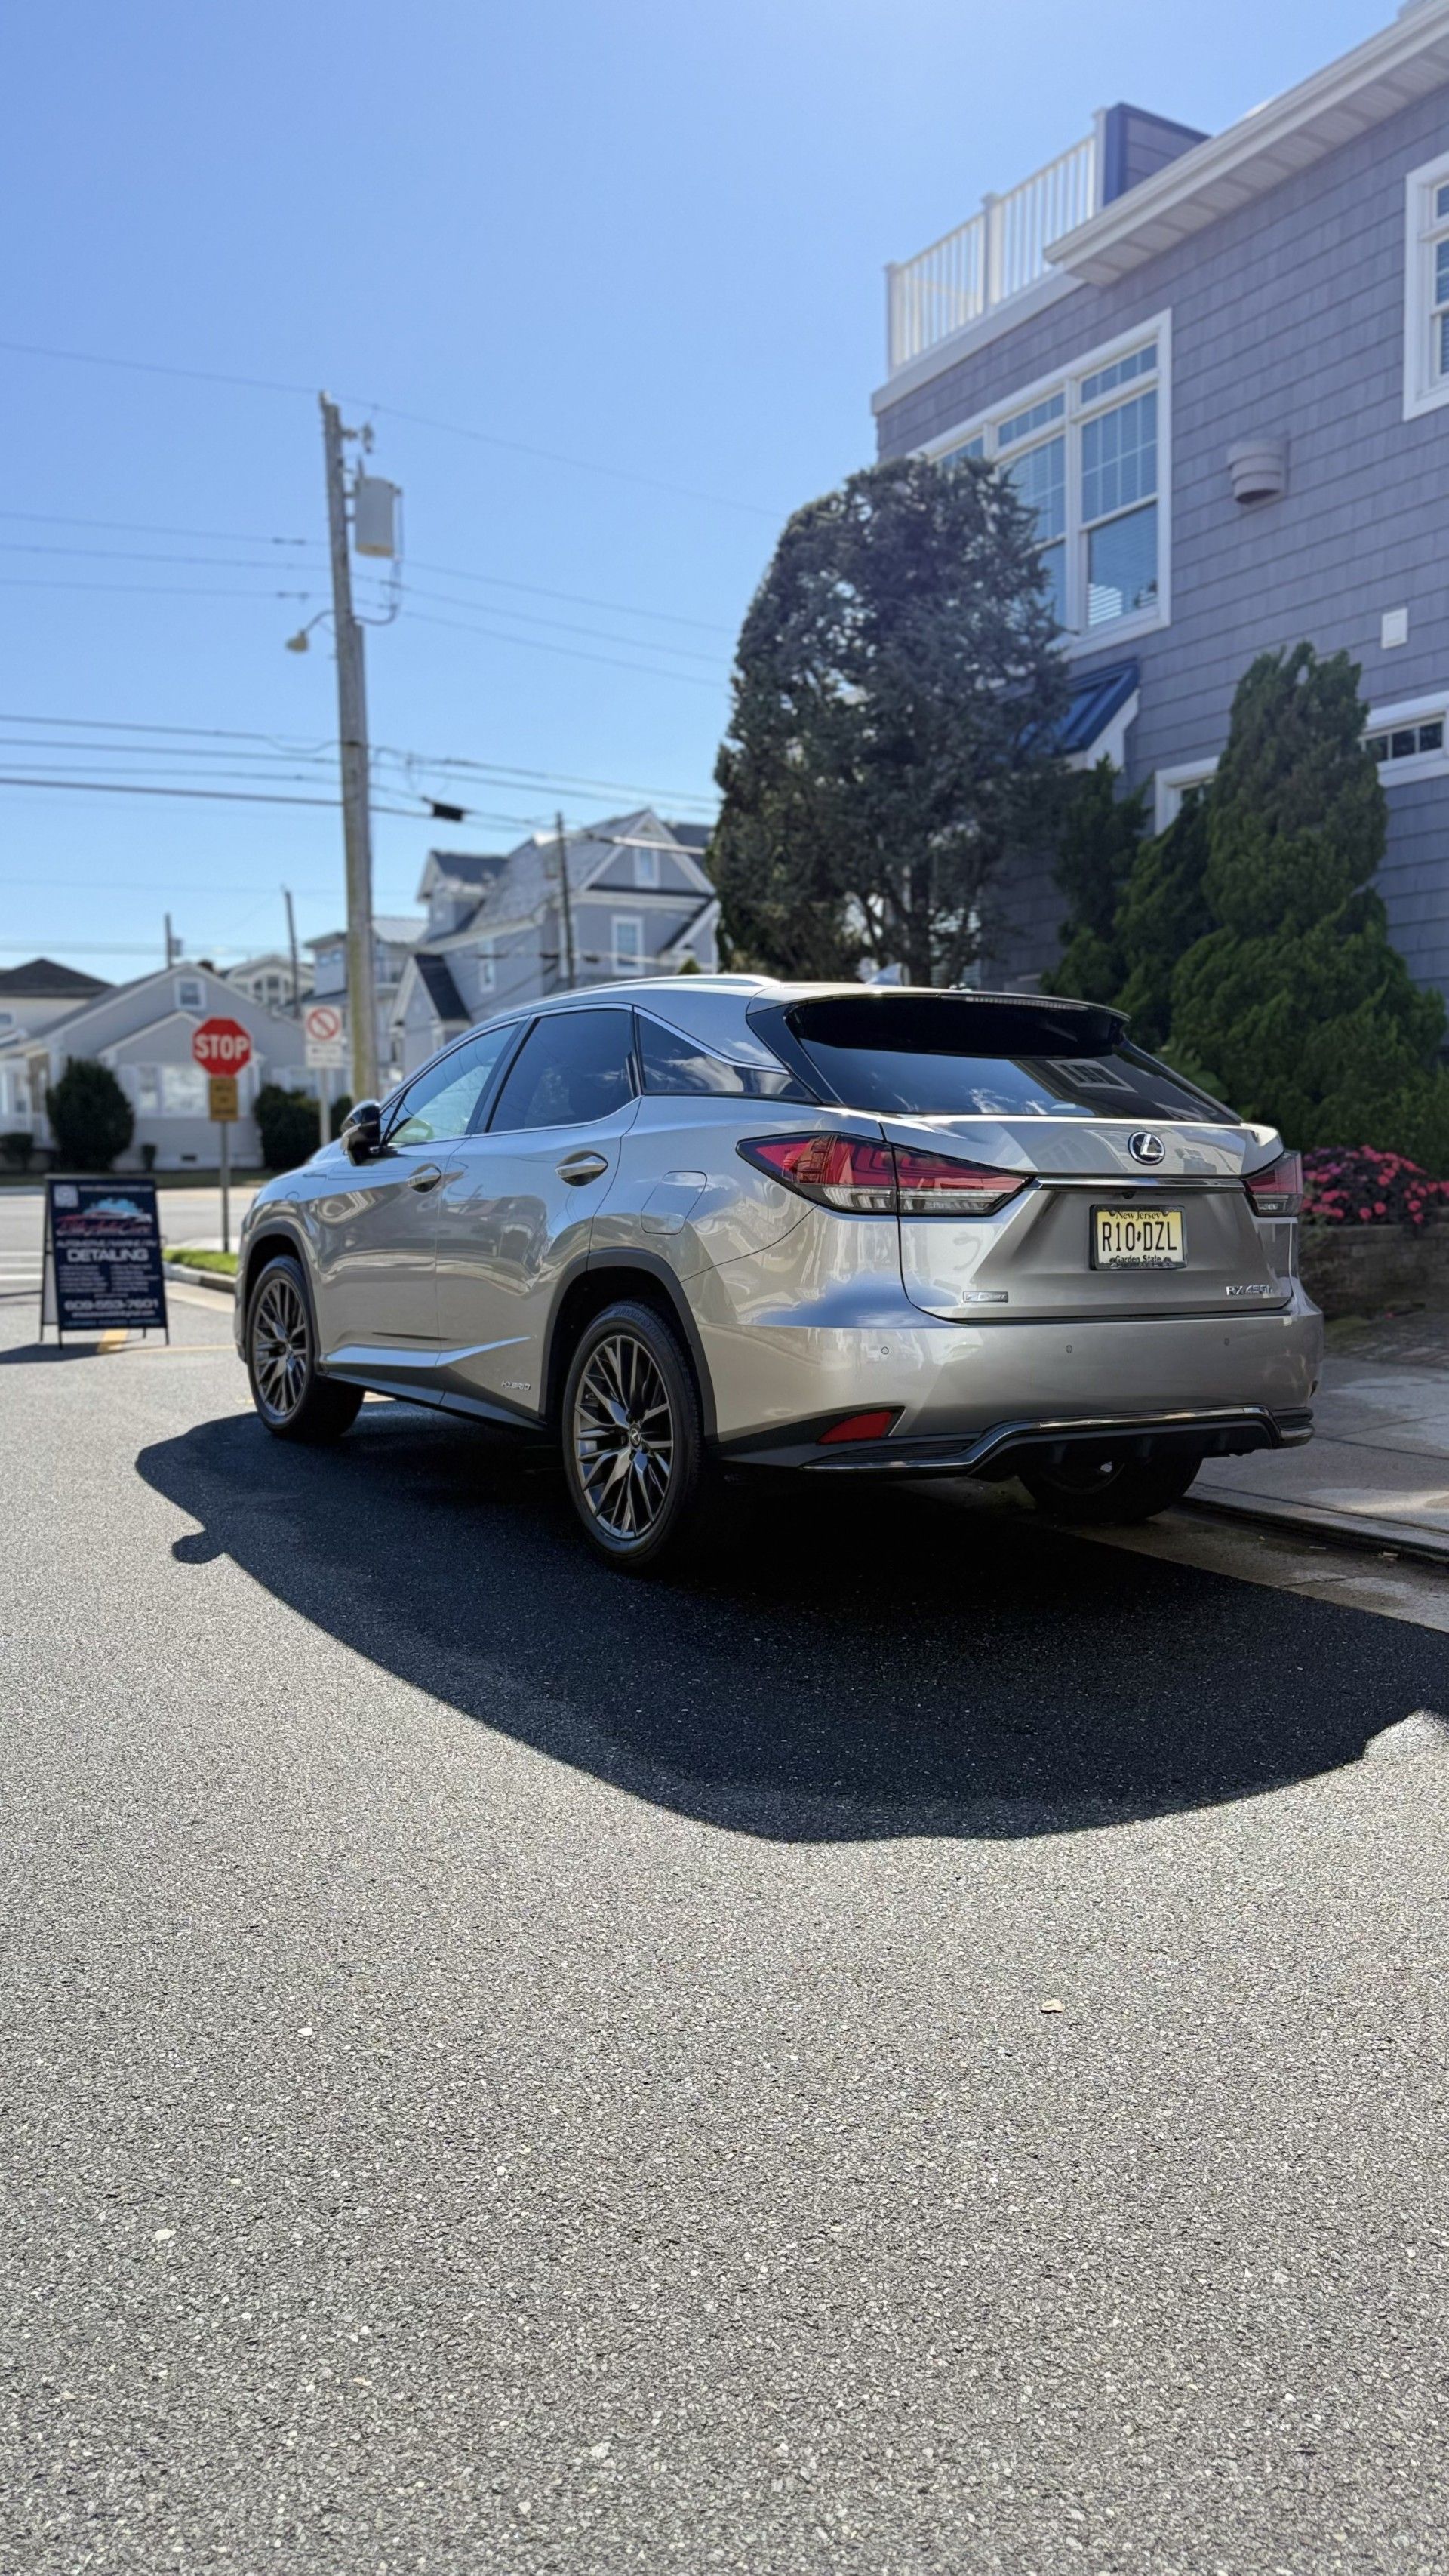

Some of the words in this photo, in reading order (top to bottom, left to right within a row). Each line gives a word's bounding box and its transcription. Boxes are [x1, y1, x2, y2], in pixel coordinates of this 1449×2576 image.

[195, 1033, 249, 1060] STOP
[1116, 1211, 1135, 1220] New
[1136, 1211, 1161, 1222] Jersey
[66, 1248, 149, 1263] DETAILING
[1143, 1254, 1161, 1263] State
[501, 1380, 531, 1390] HYBRID
